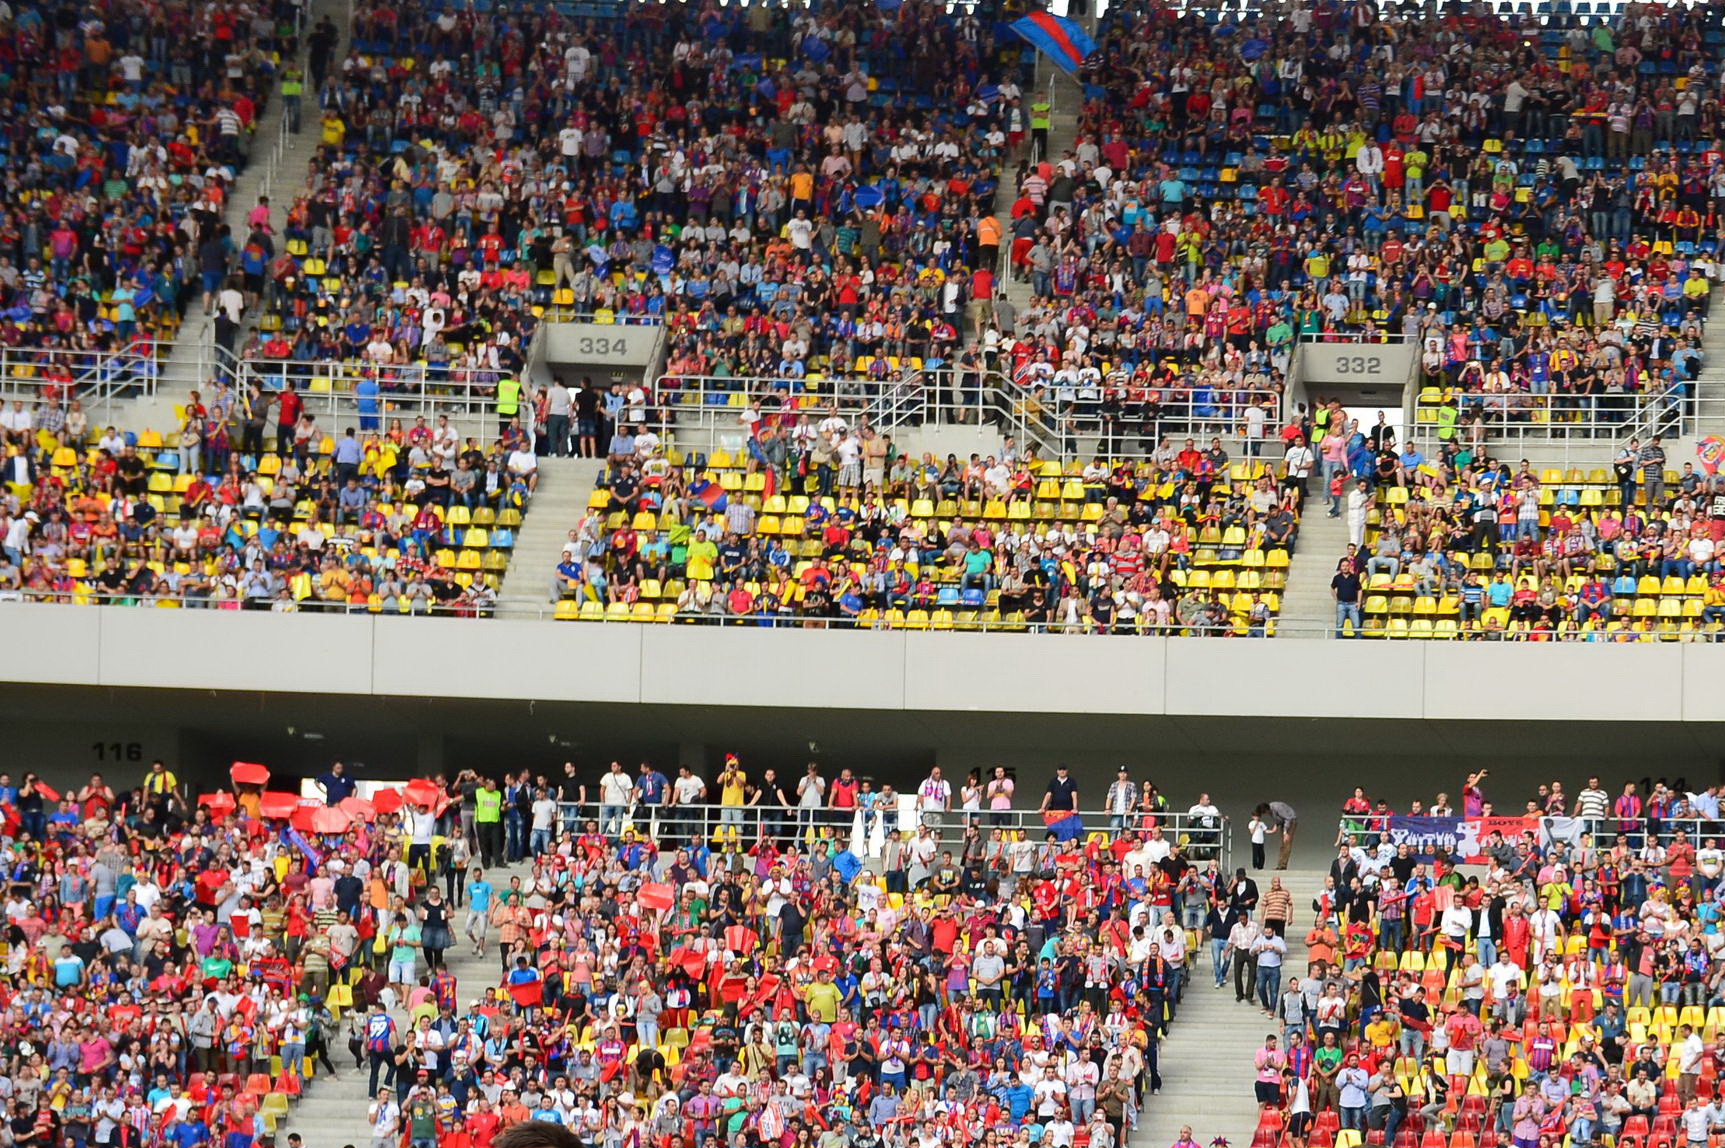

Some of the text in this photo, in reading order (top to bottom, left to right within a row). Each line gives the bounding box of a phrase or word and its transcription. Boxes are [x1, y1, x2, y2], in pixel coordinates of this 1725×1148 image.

[579, 337, 628, 355] 334
[1336, 356, 1382, 374] 332
[93, 742, 143, 762] 116
